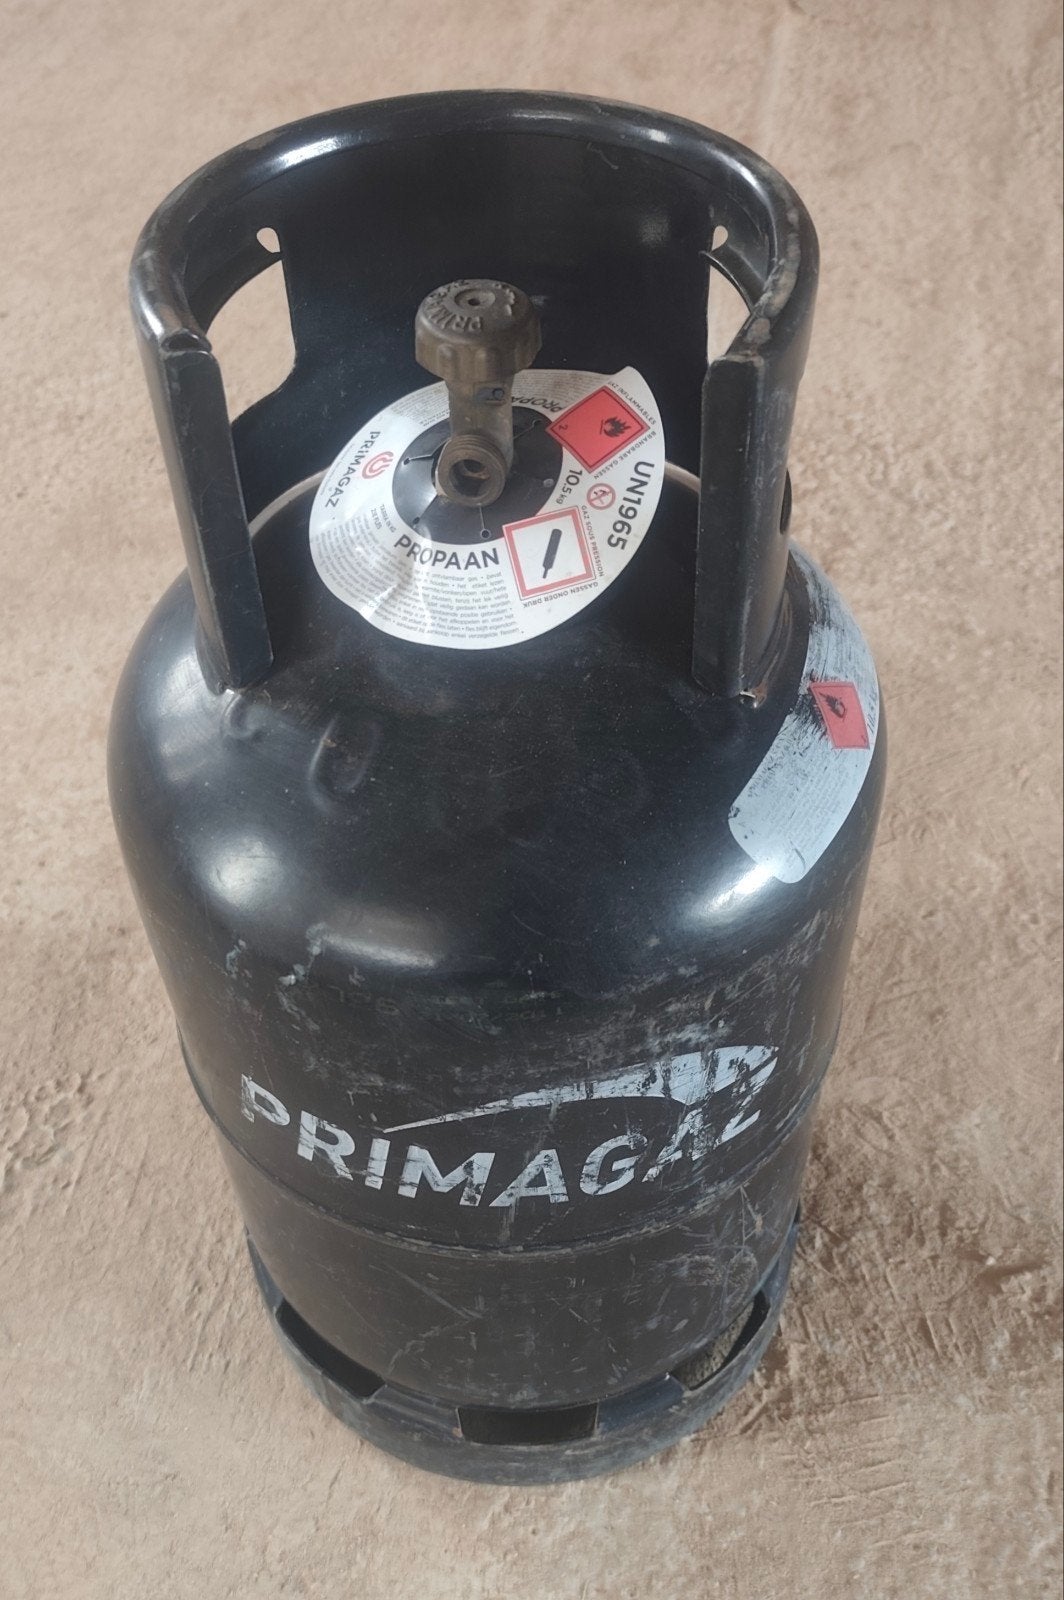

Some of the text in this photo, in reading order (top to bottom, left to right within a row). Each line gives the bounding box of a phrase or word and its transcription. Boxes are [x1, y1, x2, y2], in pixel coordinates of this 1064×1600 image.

[511, 396, 563, 412] PROPA
[618, 387, 657, 425] INFLAMMABLES
[593, 431, 657, 480] BRANDBARE GASSEN
[607, 461, 655, 550] UN1965
[393, 534, 500, 570] PROPAAN
[581, 505, 604, 577] GAZ SOUS PRESSION
[523, 582, 599, 608] GASSEN ONDER DRUK
[241, 1057, 778, 1208] PRIMAGAZ
